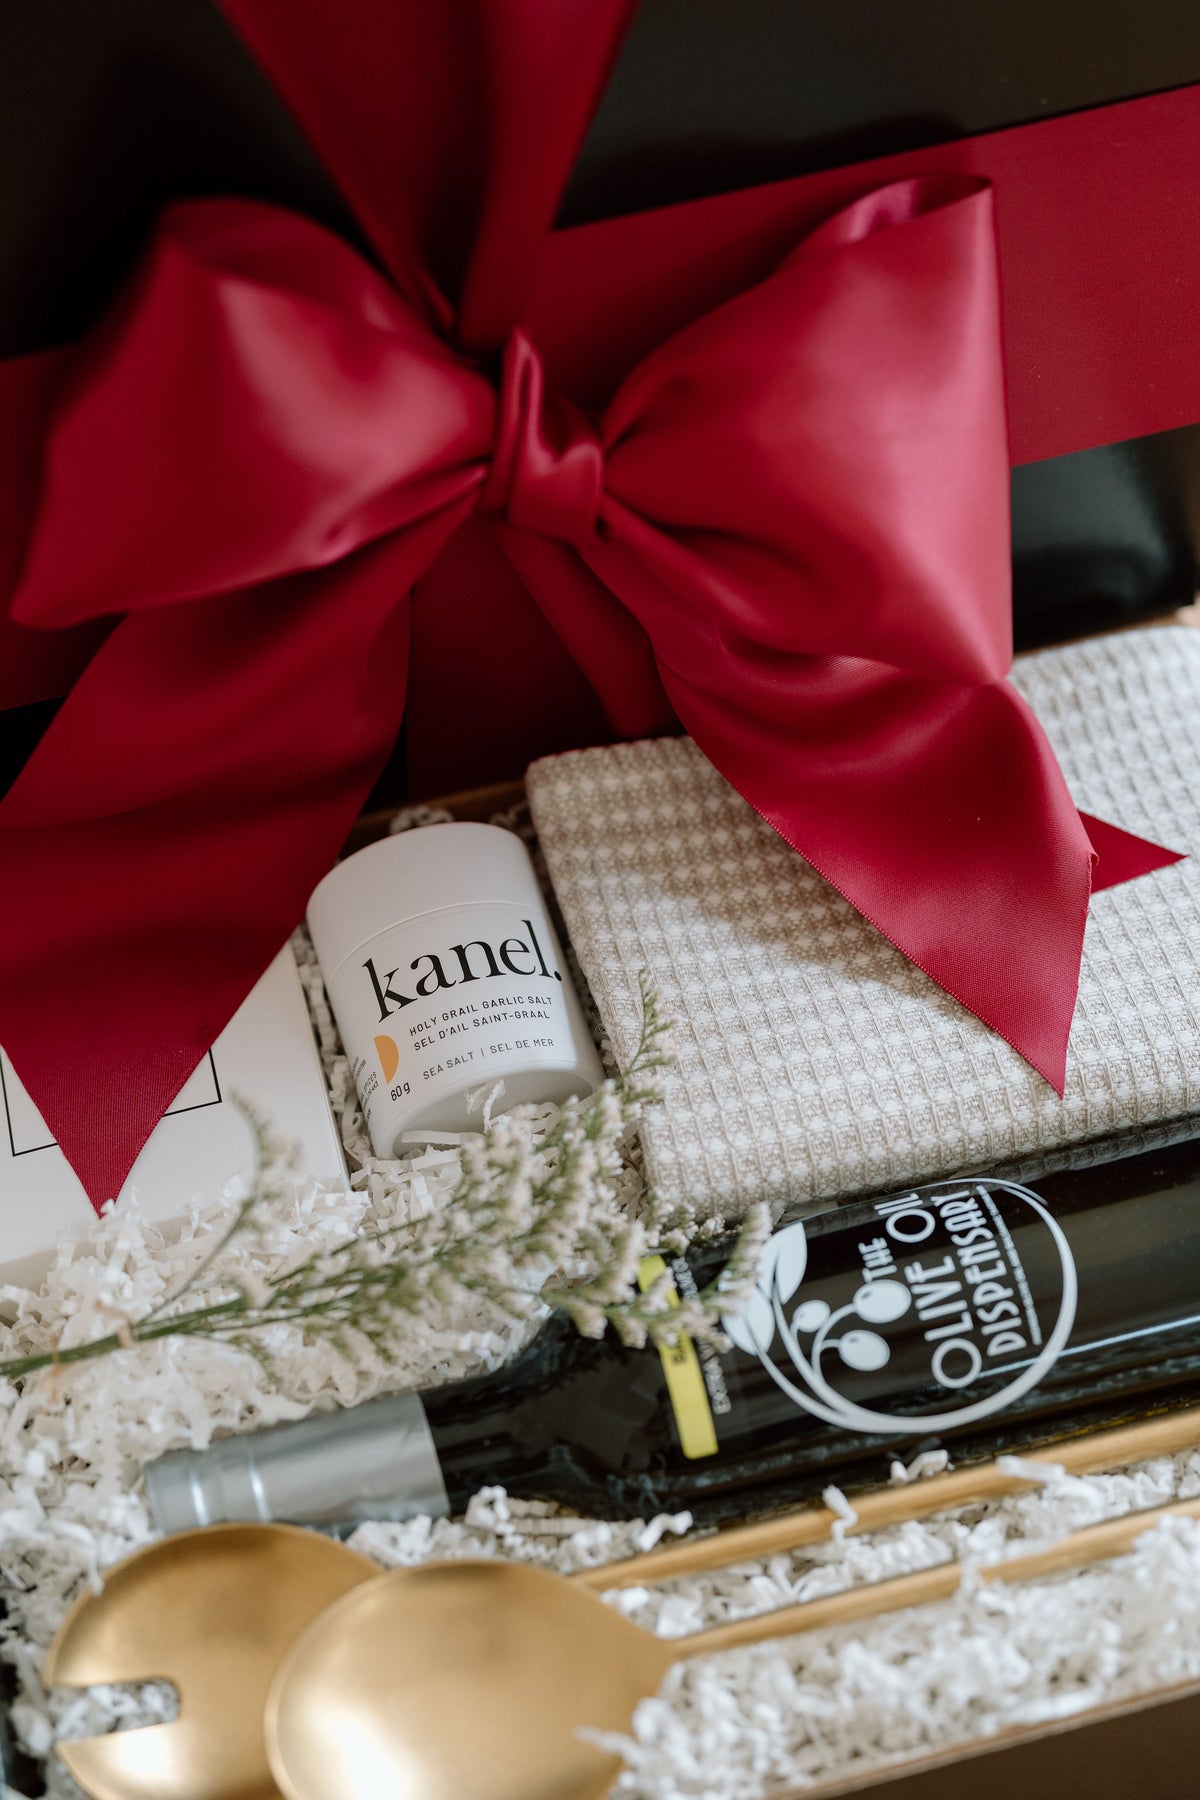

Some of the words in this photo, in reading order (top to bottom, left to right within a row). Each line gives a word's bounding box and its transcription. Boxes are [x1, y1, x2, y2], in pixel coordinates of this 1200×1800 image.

[409, 1016, 438, 1037] HOLY
[442, 1004, 478, 1021] GRAIL
[482, 996, 525, 1010] GARLIC
[527, 996, 552, 1006] SALT
[414, 1035, 435, 1051] SEL
[439, 1022, 469, 1040] D'AIL
[473, 1010, 550, 1028] SAINT-GRAAL
[423, 1064, 444, 1080] SEA
[446, 1051, 475, 1069] SALT
[490, 1043, 513, 1055] SEL
[516, 1039, 531, 1050] DE
[534, 1038, 555, 1048] MER
[874, 1193, 936, 1244] OIL
[858, 1237, 898, 1283] THE
[930, 1190, 1028, 1358] DISPENSARY
[904, 1255, 983, 1389] OLIVE
